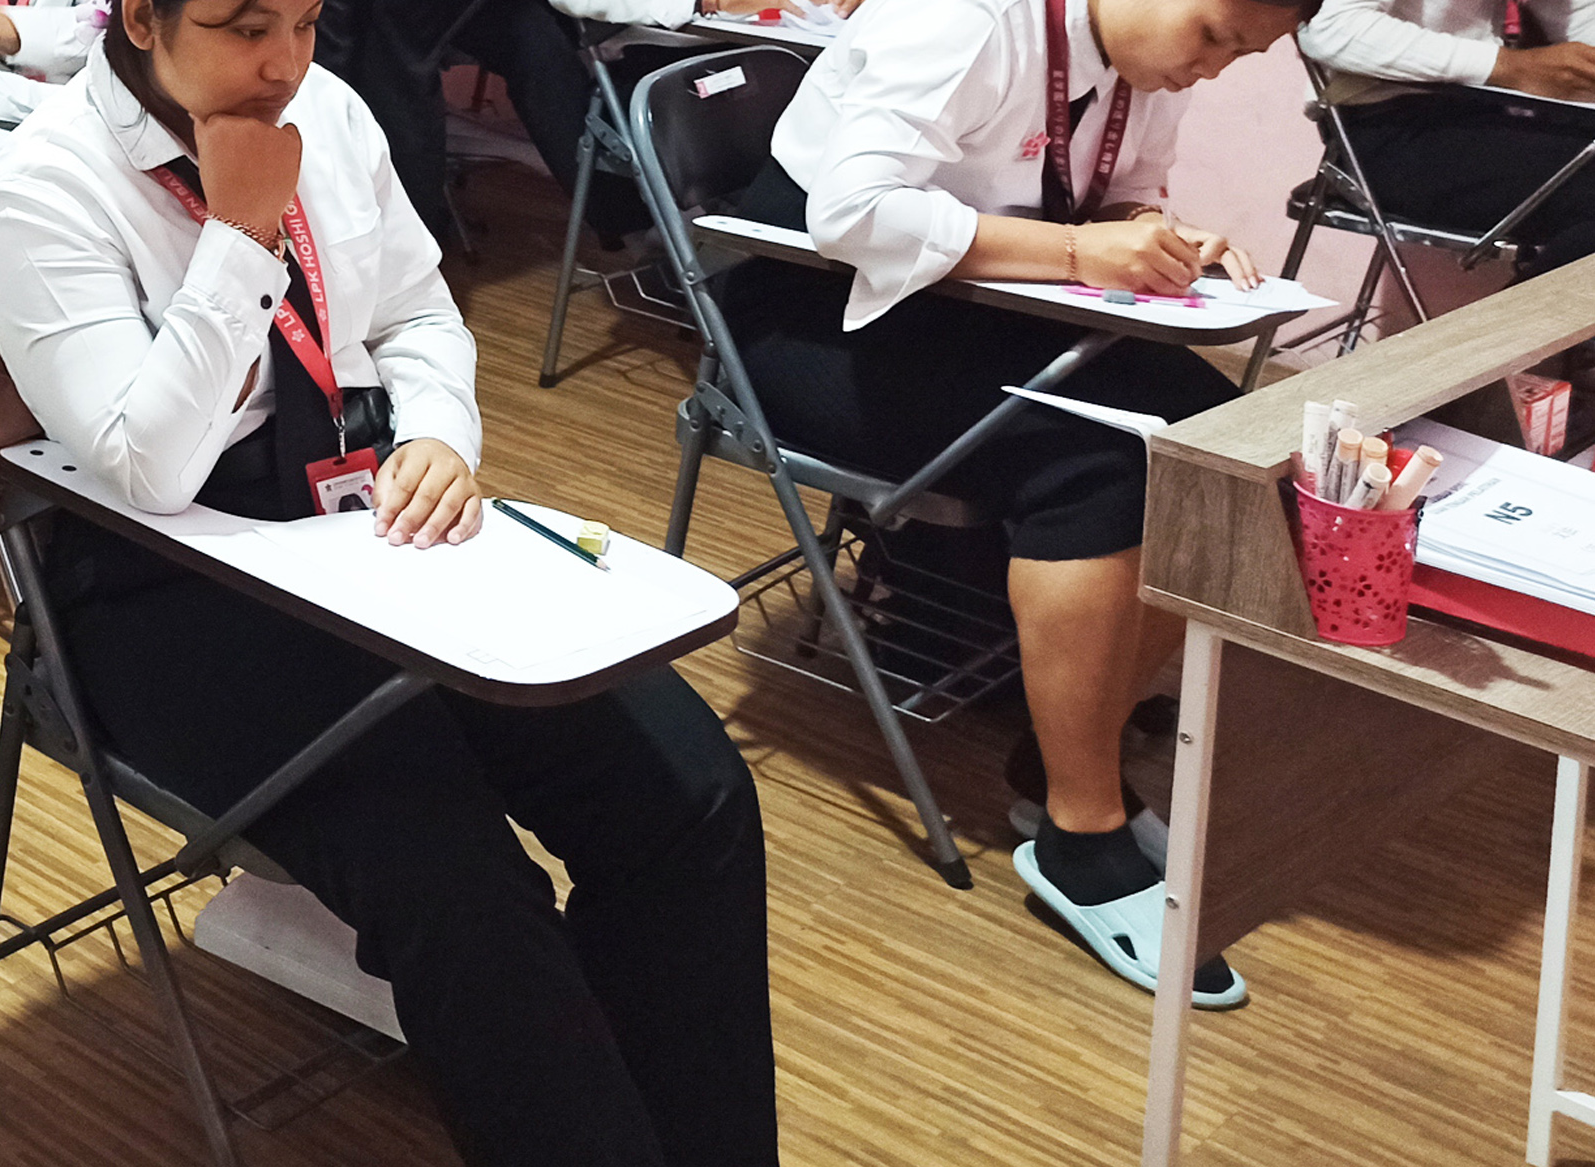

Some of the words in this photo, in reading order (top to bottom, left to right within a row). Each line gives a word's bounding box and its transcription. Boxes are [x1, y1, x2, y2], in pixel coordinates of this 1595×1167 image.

[289, 217, 317, 268] HOSHI
[306, 270, 324, 302] LPK
[1483, 501, 1534, 525] N5
